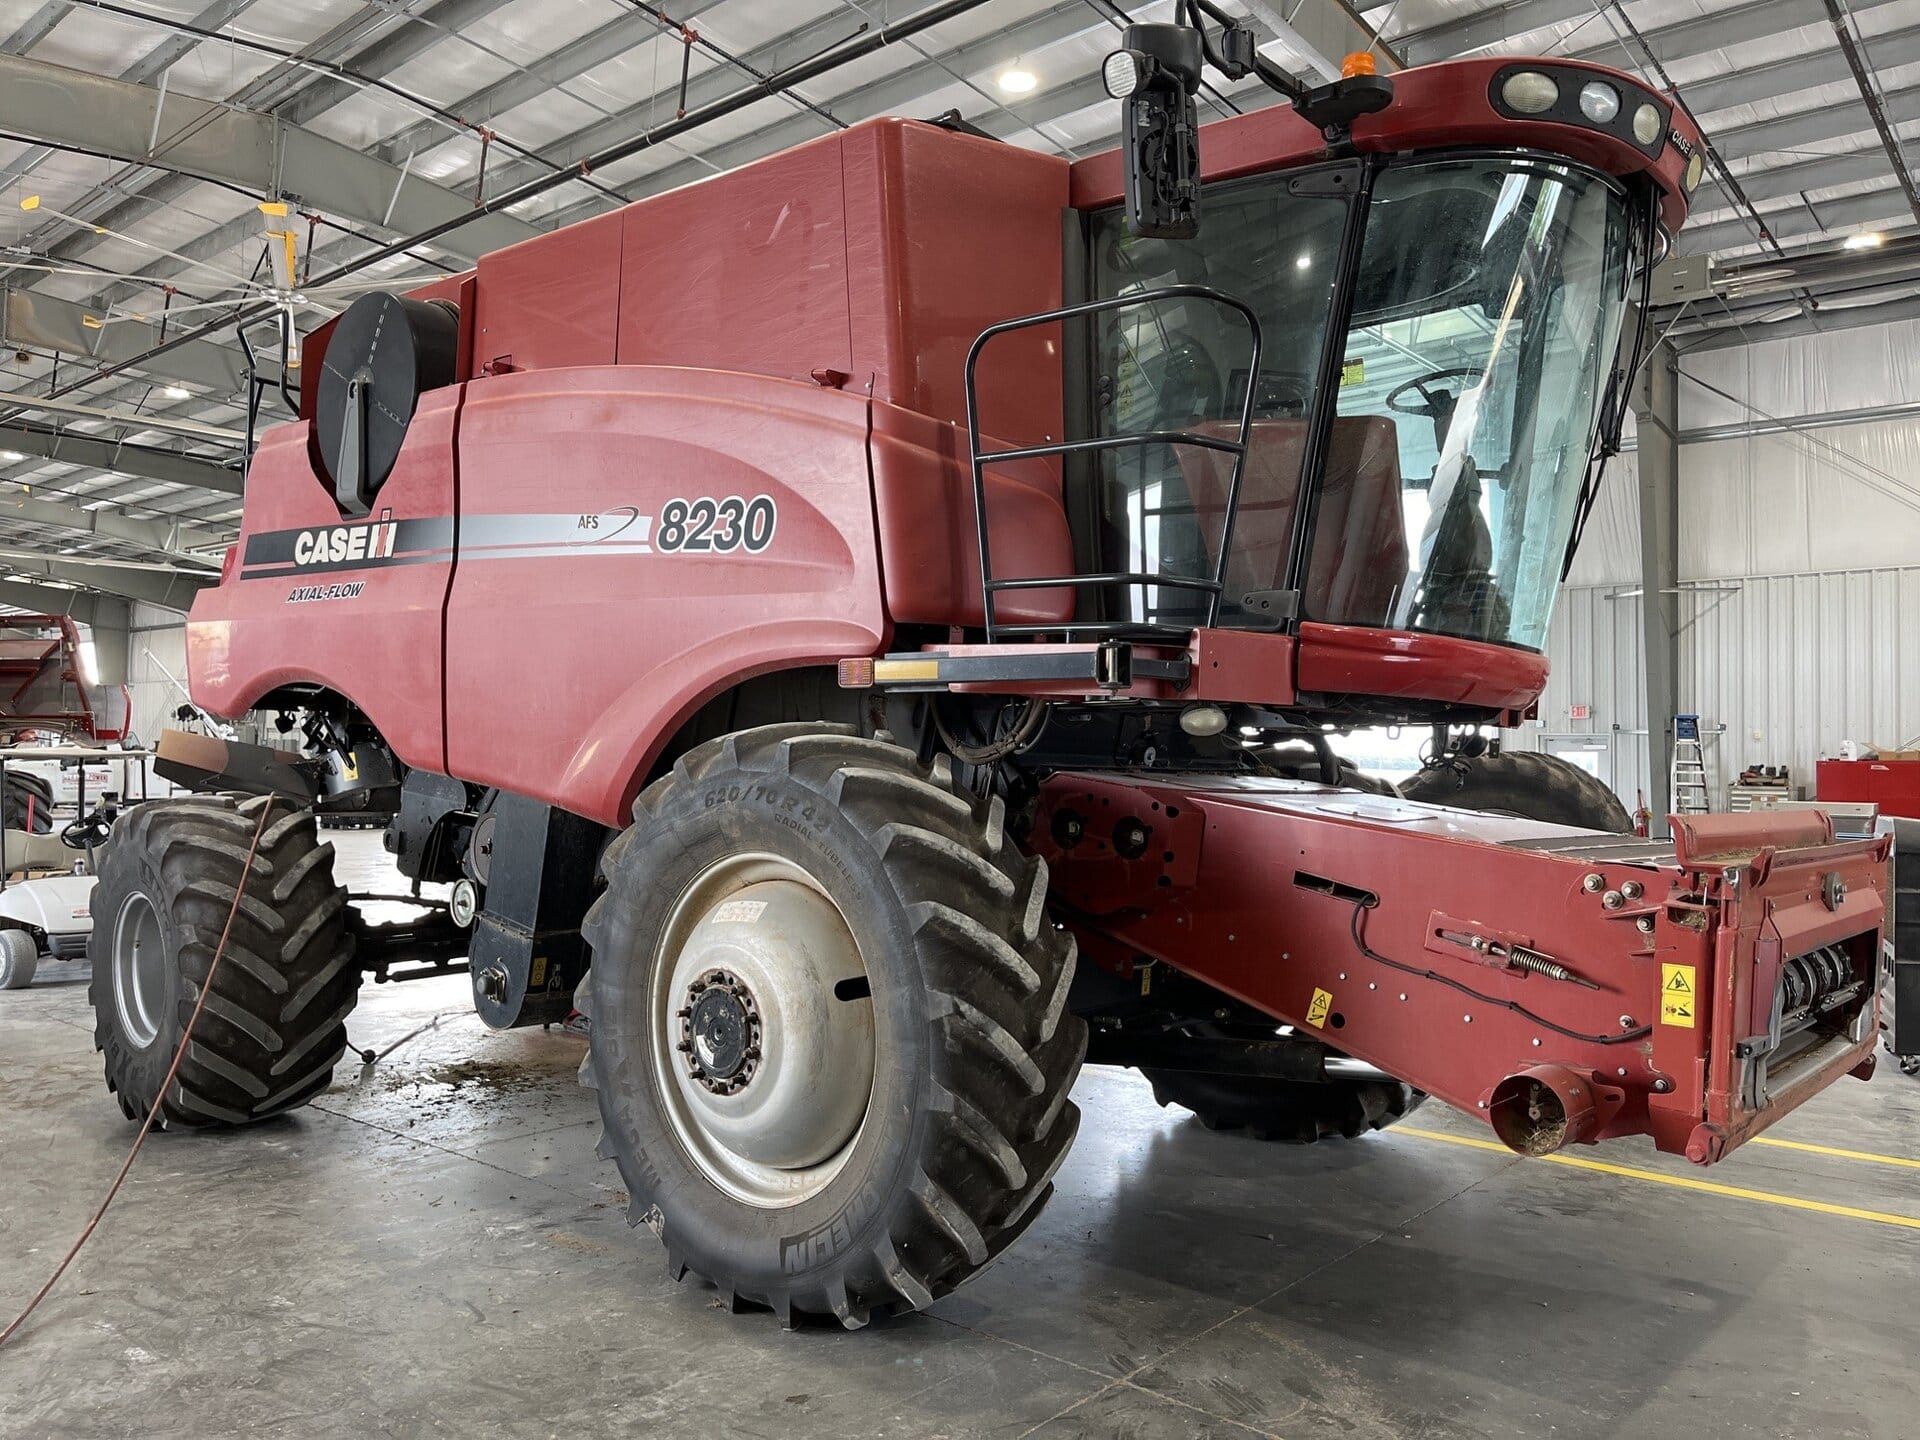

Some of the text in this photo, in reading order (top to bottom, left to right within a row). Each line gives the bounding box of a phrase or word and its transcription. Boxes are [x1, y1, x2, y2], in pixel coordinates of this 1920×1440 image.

[1671, 129, 1692, 155] CASE
[577, 515, 600, 530] AFS
[656, 494, 777, 554] 8230
[286, 582, 366, 602] AXIAL-FLOW
[704, 785, 777, 809] 620/70
[773, 813, 814, 841] RADIAL
